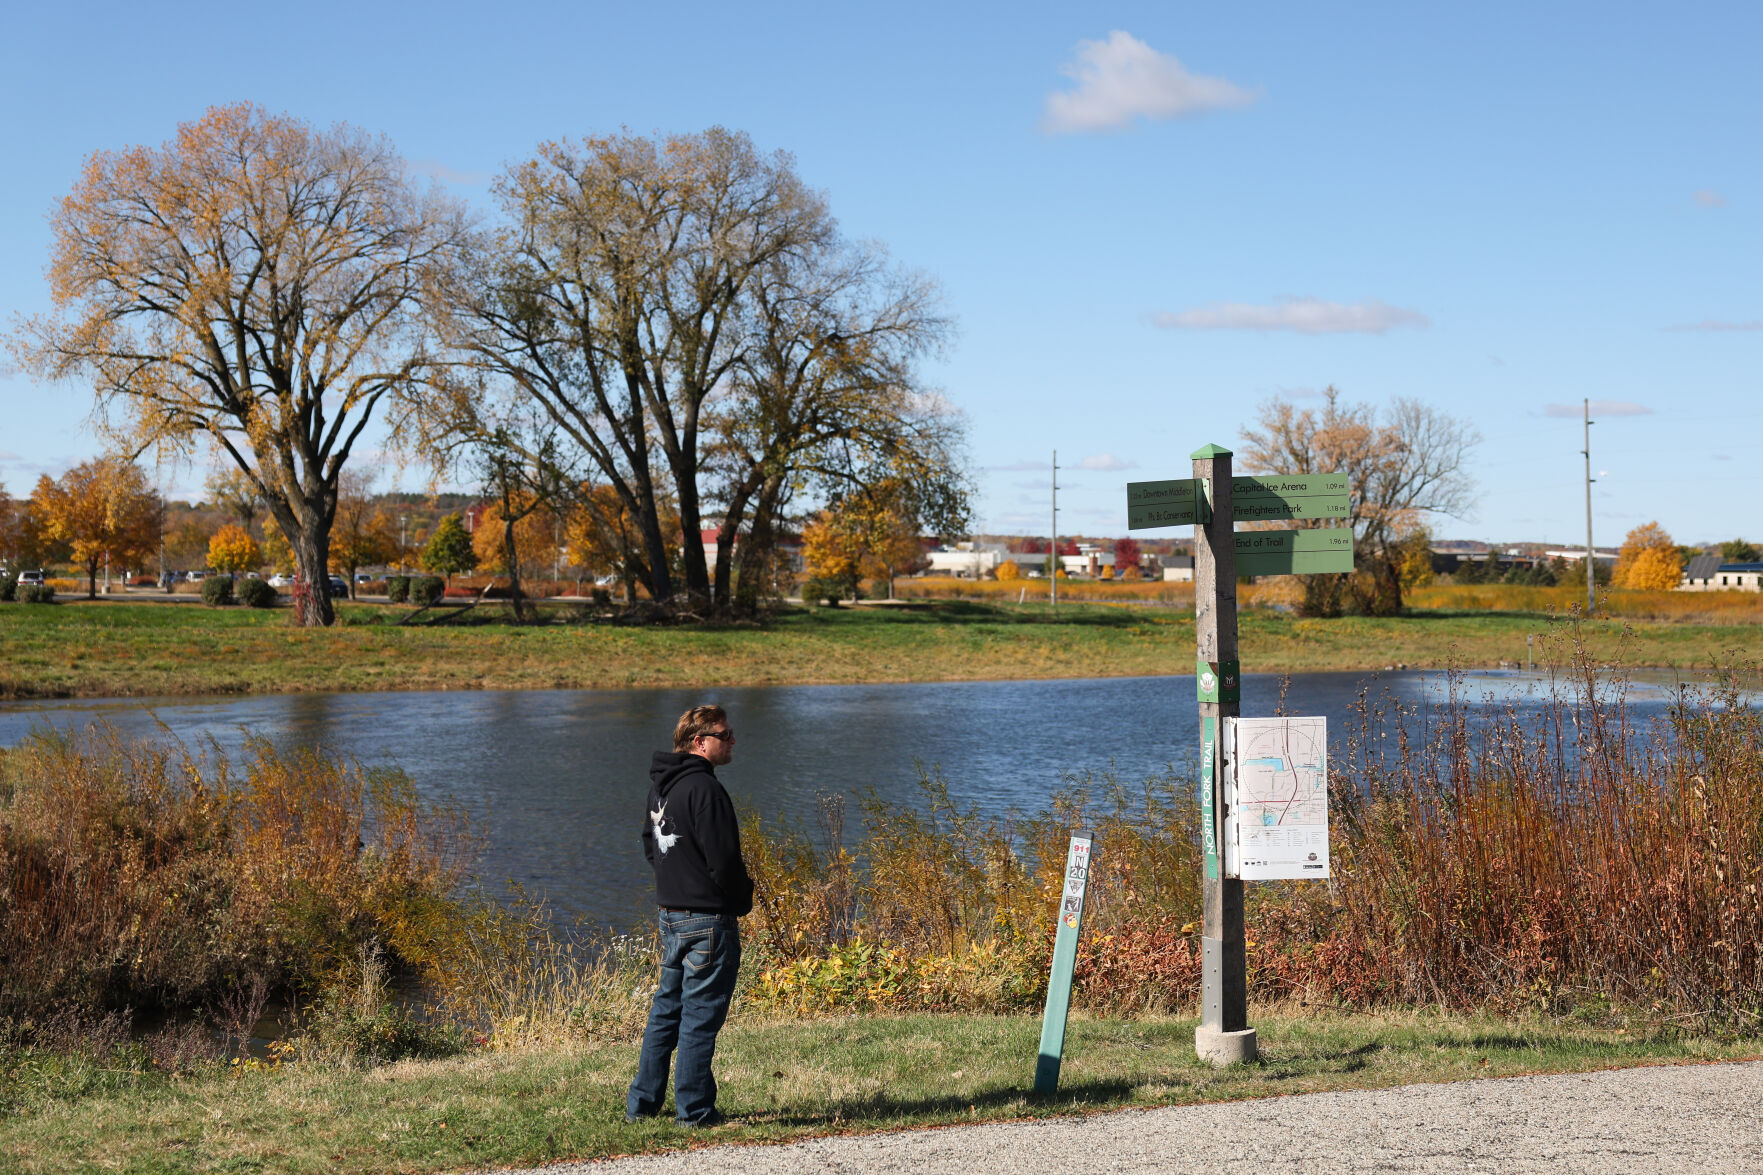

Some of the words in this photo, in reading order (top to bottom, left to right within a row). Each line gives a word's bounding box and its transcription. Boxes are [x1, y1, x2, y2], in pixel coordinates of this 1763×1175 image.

[1266, 483, 1279, 492] Ice
[1281, 482, 1307, 491] Arena
[1233, 506, 1280, 516] Firefighters
[1282, 504, 1302, 513] Park
[1235, 538, 1251, 548] End
[1253, 538, 1262, 547] of
[1265, 537, 1284, 547] Trail
[1204, 740, 1213, 769] TRAIL
[1203, 775, 1212, 807] FORK
[1204, 813, 1214, 855] NORTH
[1074, 844, 1089, 853] 911
[1075, 856, 1084, 867] N
[1070, 867, 1085, 879] 20
